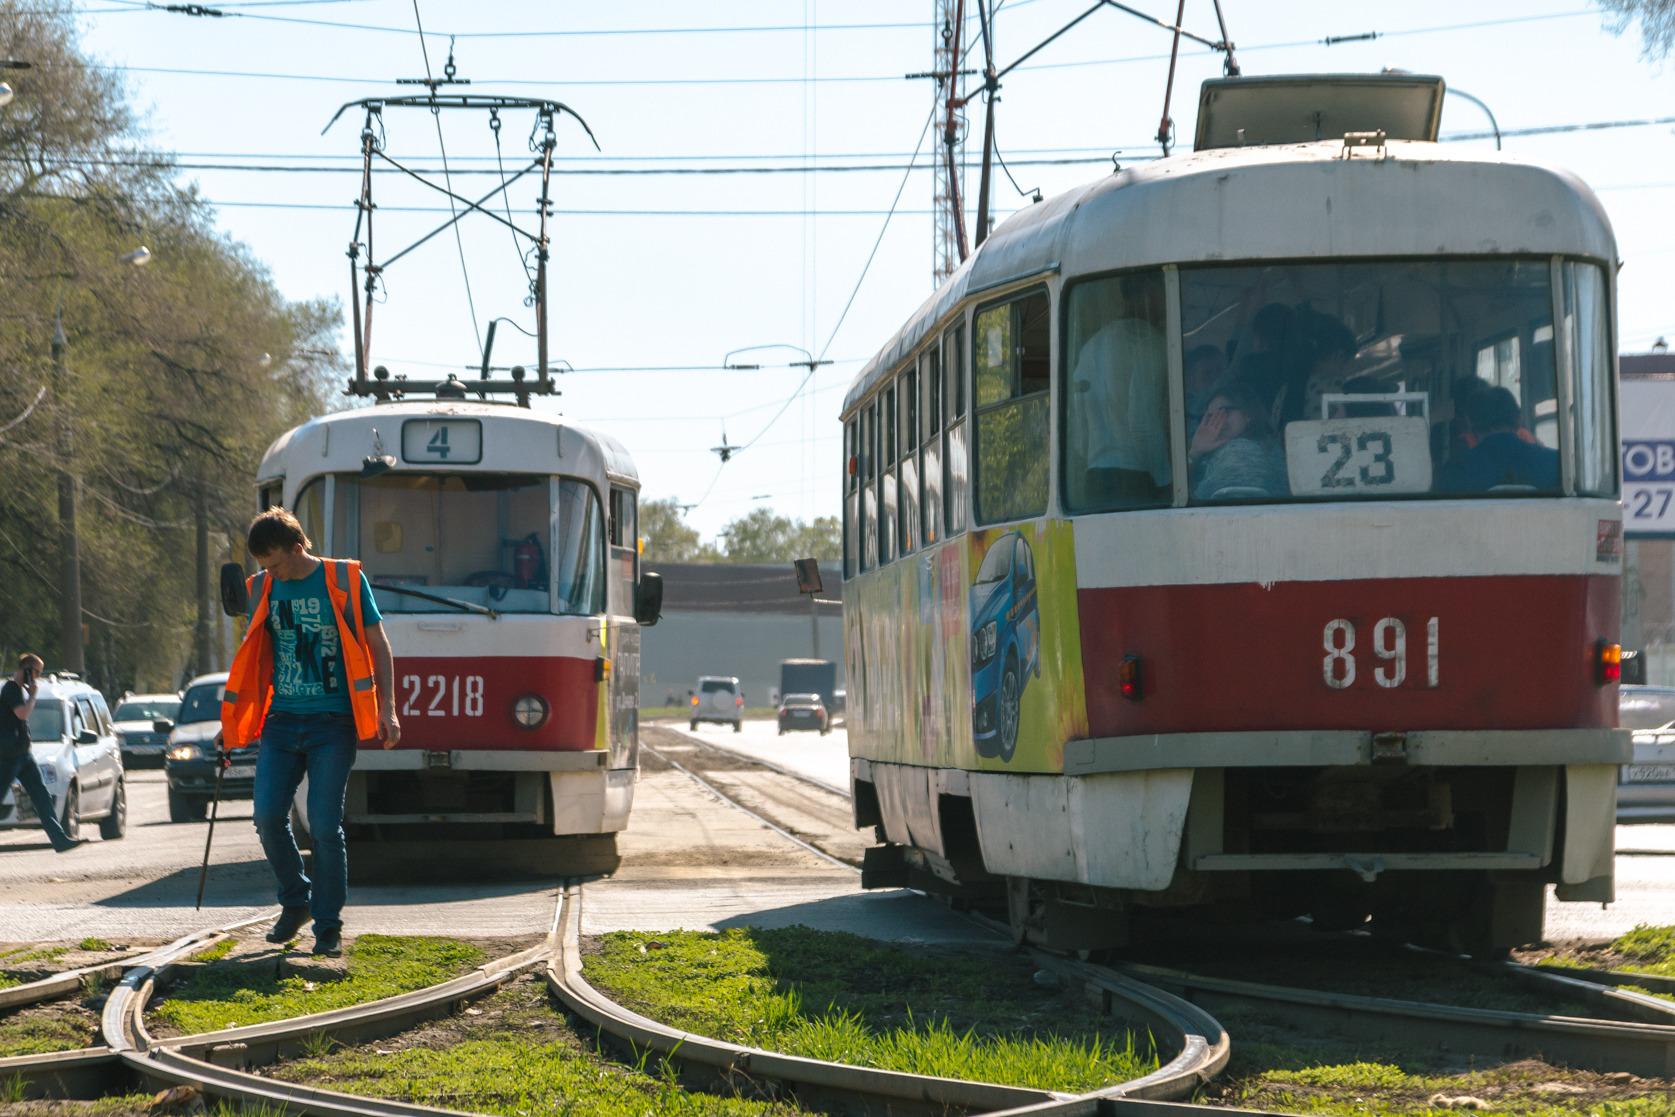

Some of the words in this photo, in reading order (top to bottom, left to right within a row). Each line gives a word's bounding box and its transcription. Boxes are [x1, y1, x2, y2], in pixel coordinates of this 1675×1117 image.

[426, 425, 451, 459] 4
[1316, 431, 1396, 489] 23
[1622, 443, 1675, 476] ОВ
[1323, 616, 1440, 689] 891
[402, 674, 484, 717] 2218
